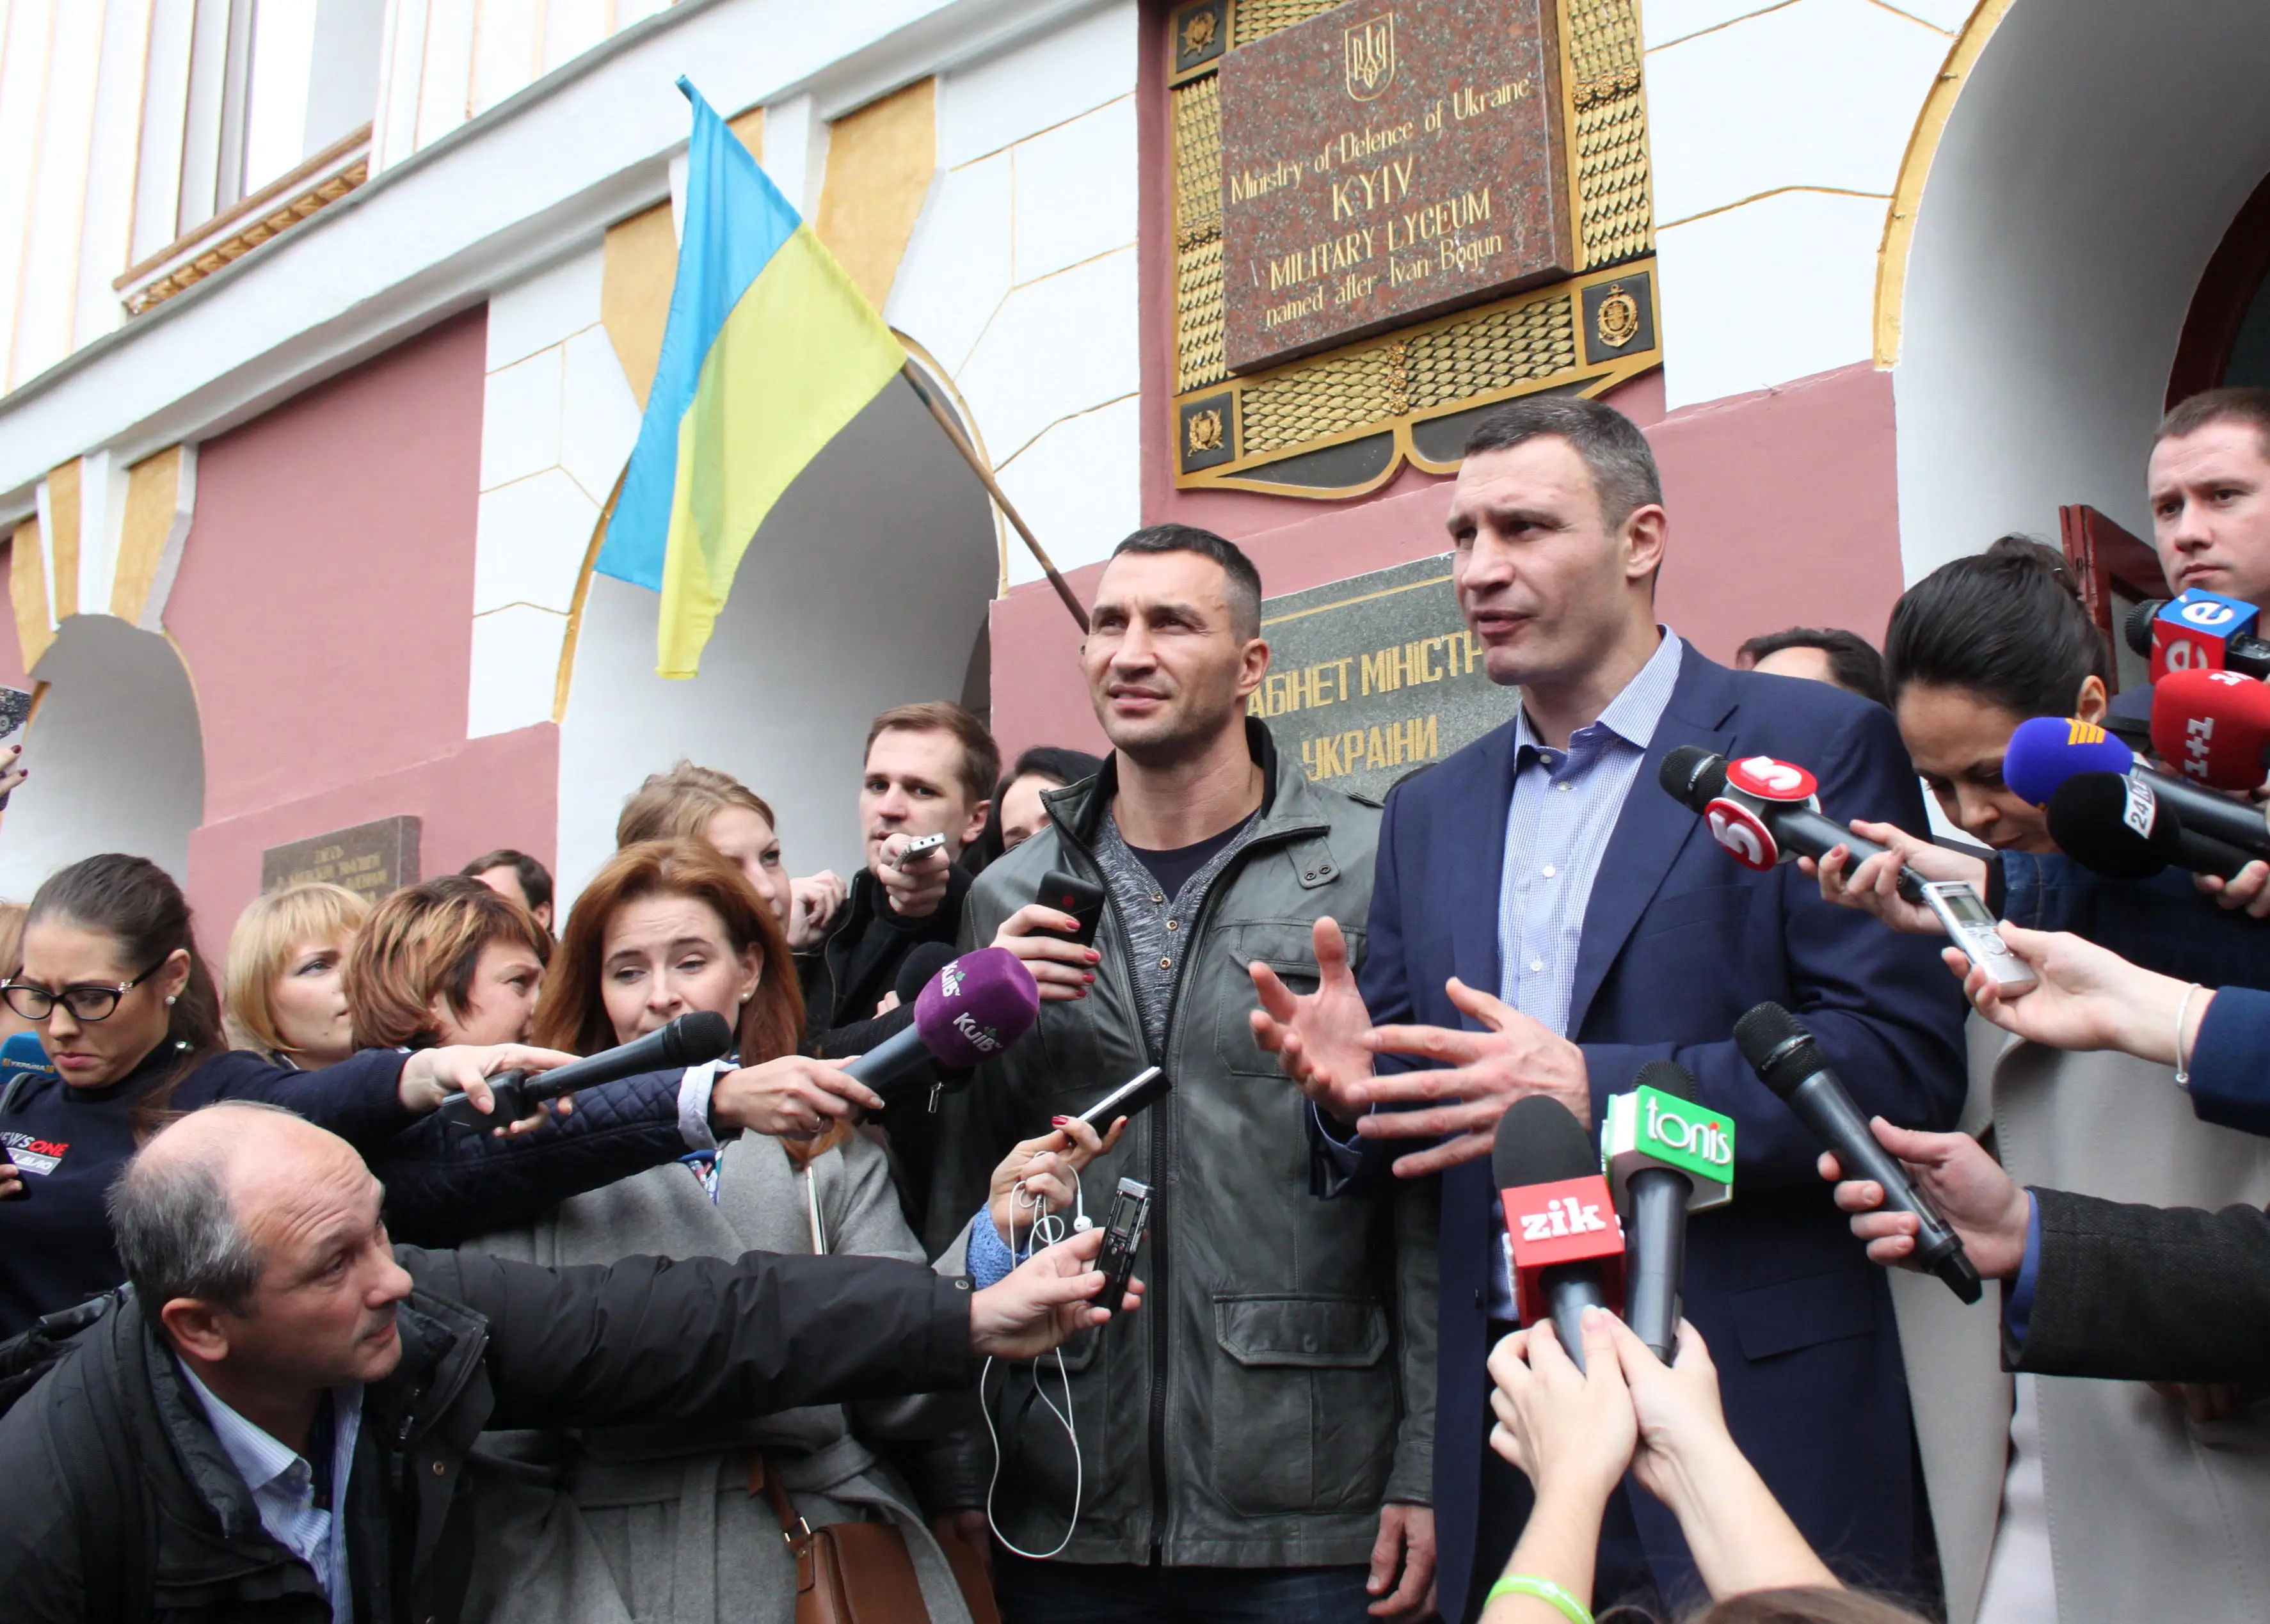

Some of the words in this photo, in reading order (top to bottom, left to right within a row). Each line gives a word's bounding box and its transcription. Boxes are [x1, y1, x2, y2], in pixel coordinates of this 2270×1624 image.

[1231, 161, 1303, 205] Ministry
[1315, 140, 1331, 173] of
[1341, 122, 1413, 163] Defence
[1425, 100, 1443, 132] of
[1453, 78, 1530, 120] Ukraine
[1332, 155, 1412, 221] KYIV
[1270, 227, 1375, 291] MILITARY
[1388, 188, 1491, 251] LYCEUM
[1267, 285, 1323, 327] named
[1336, 273, 1377, 305] after
[1391, 257, 1429, 287] Ivan
[1441, 235, 1503, 271] Bogun
[1302, 715, 1439, 781] УКРАЇНИ
[1741, 756, 1802, 792] 5
[2184, 717, 2214, 778] 1+1
[1709, 811, 1762, 864] 5
[1646, 1096, 1731, 1165] tonis
[1521, 1197, 1606, 1241] zik
